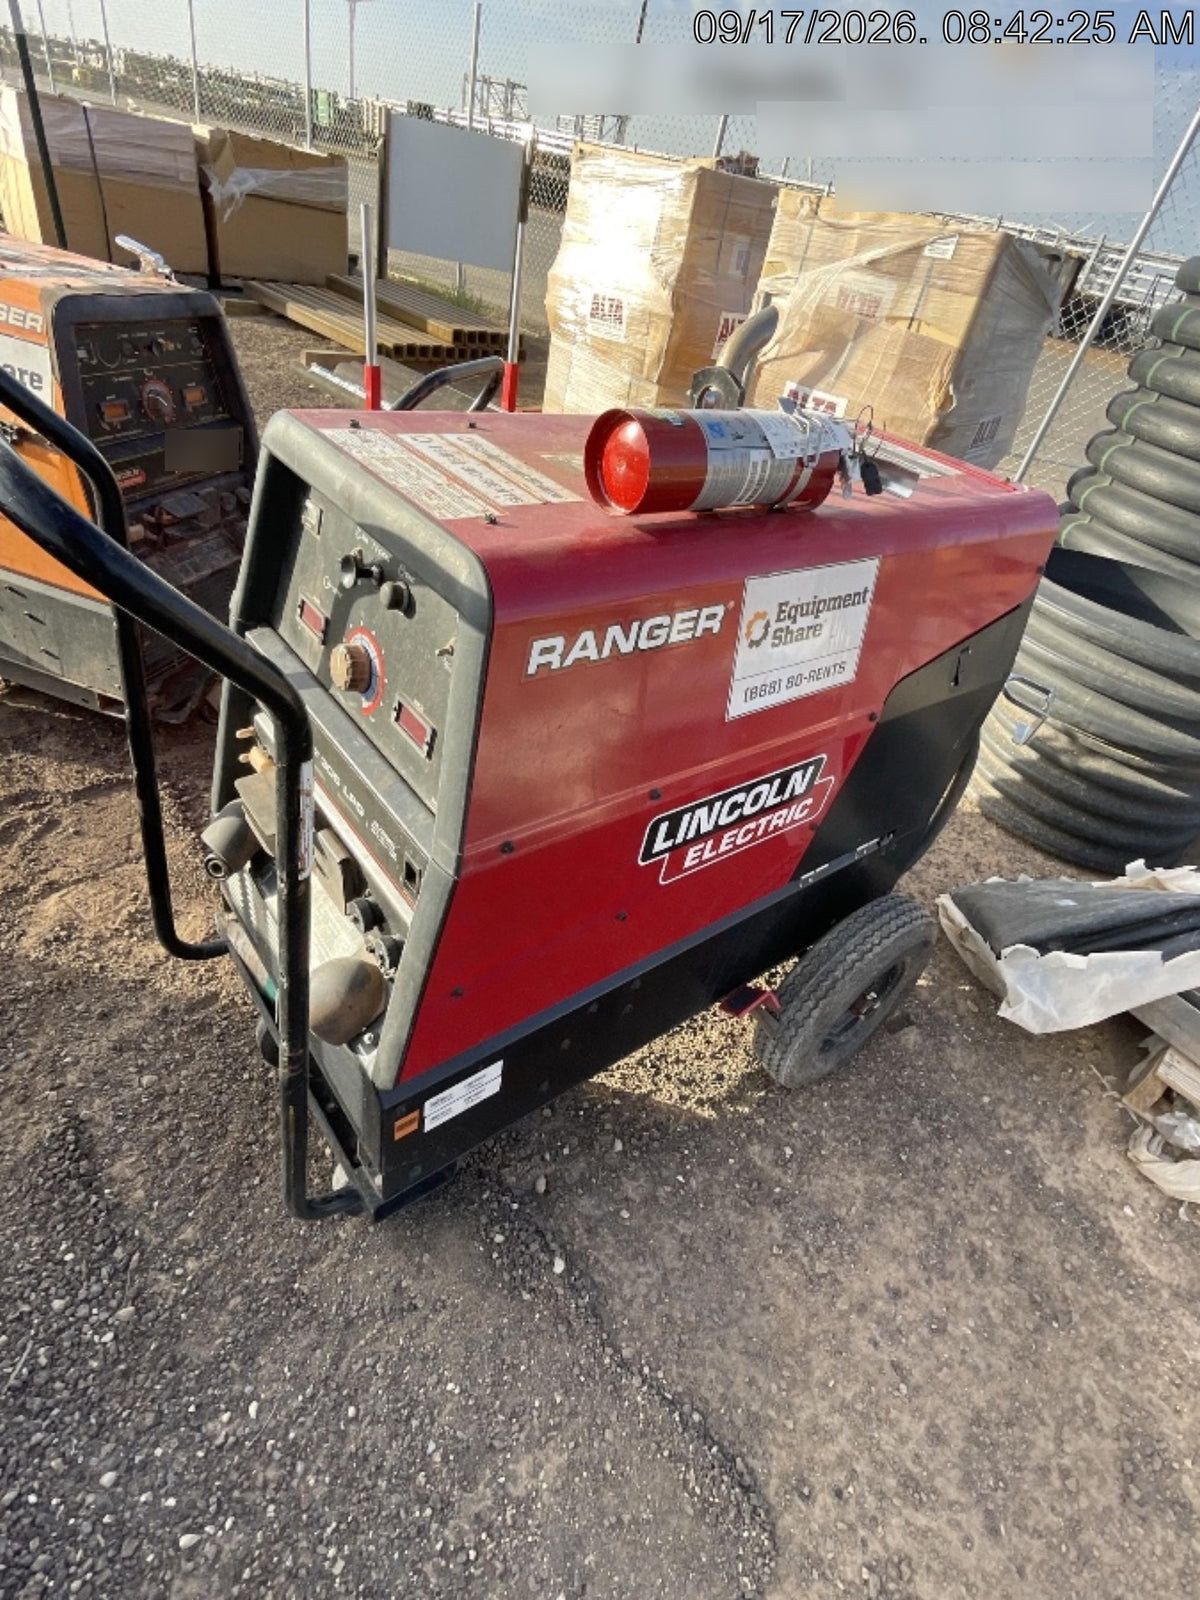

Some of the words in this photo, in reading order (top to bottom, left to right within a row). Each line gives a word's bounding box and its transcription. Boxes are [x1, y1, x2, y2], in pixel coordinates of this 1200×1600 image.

[775, 586, 870, 624] Equipment
[526, 605, 725, 676] RANGER
[770, 621, 823, 648] Share
[743, 679, 783, 703] (888)
[651, 765, 815, 855] LINCOLN
[682, 797, 813, 869] ELECTRIC
